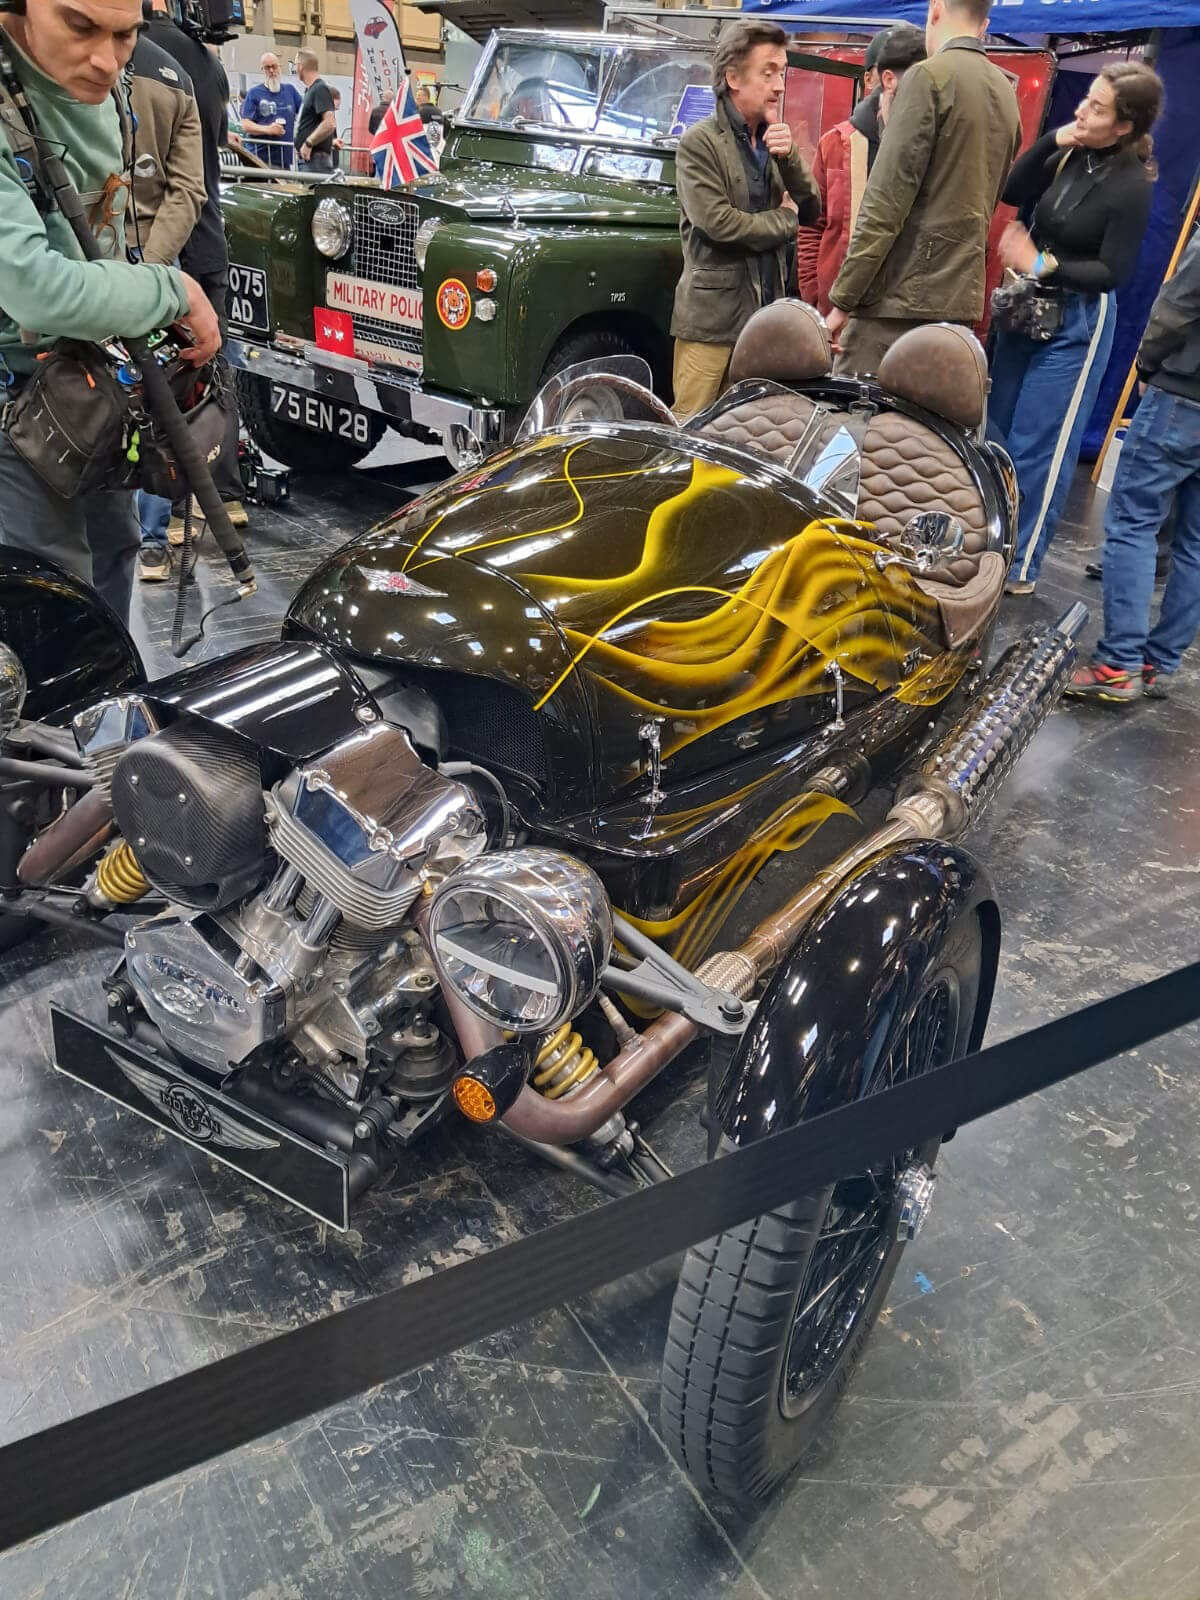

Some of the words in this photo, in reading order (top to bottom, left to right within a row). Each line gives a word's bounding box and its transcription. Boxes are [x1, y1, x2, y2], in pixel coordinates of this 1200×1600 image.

[231, 296, 253, 323] AD
[333, 280, 386, 312] MILITARY
[160, 1090, 221, 1134] MORGAN
